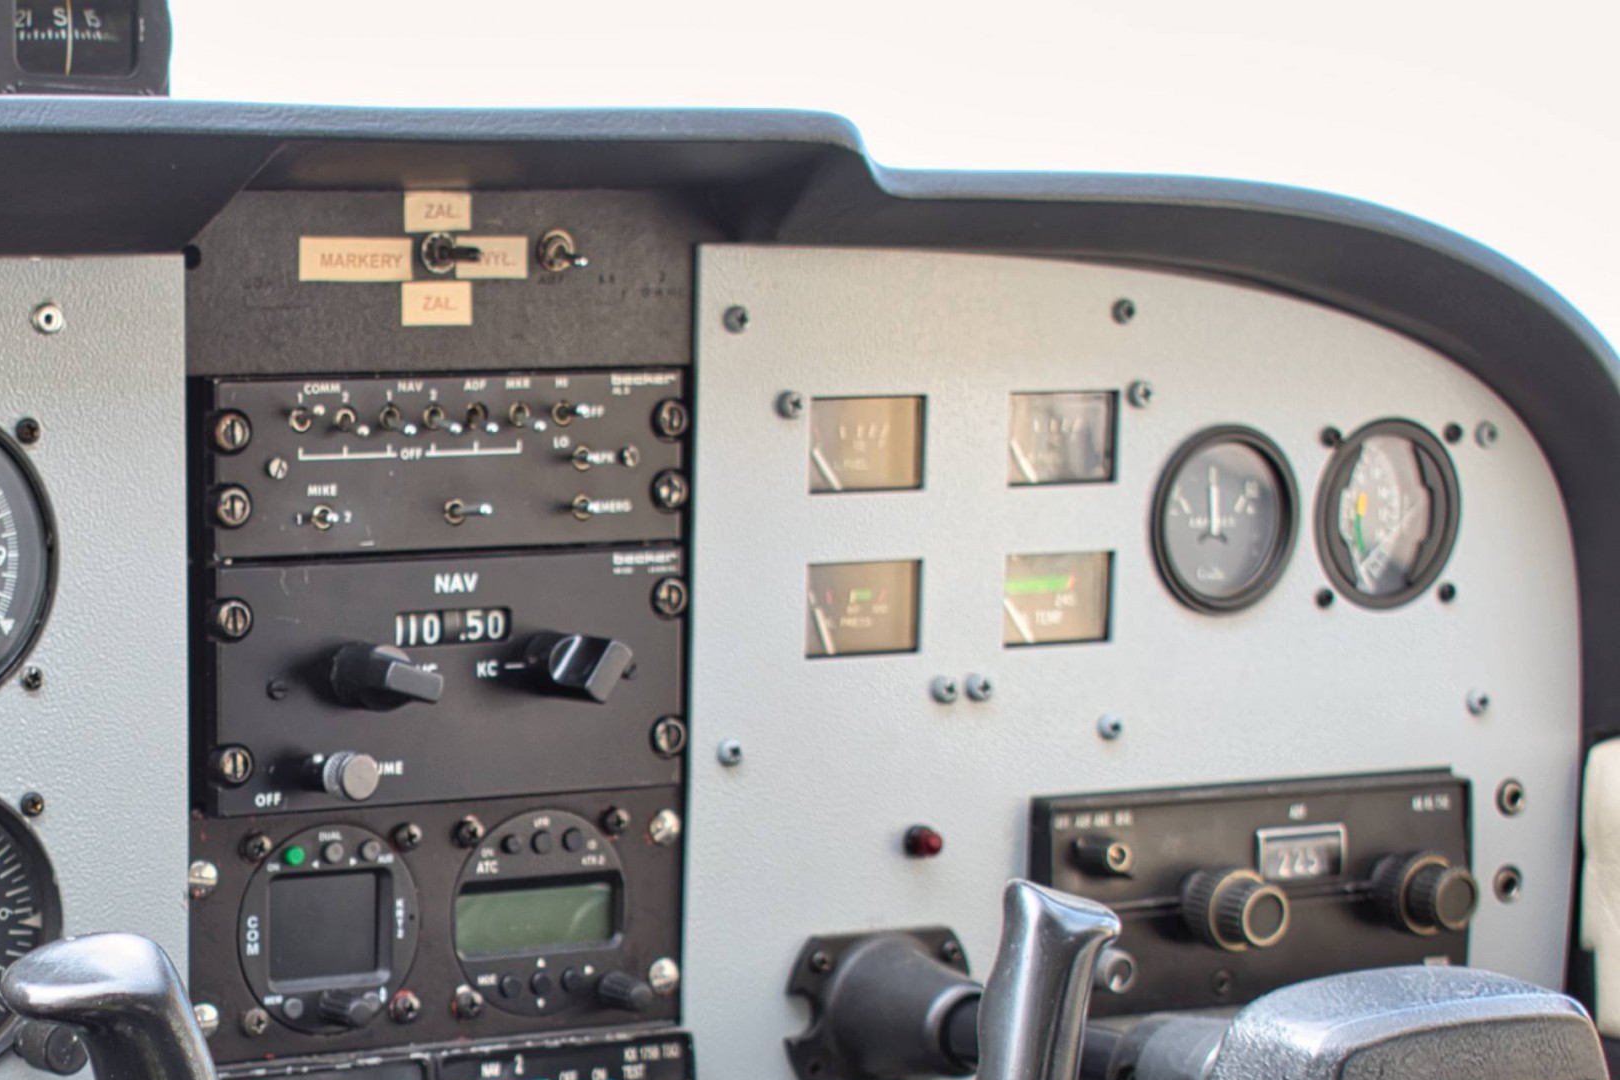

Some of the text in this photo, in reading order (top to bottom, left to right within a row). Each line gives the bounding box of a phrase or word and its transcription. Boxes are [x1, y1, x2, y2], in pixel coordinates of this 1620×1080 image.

[319, 252, 404, 269] MARKERY
[303, 382, 341, 395] COMM
[397, 380, 424, 393] NAV
[463, 379, 487, 391] ADF
[400, 447, 423, 460] OFF
[307, 484, 338, 497] MIKE
[433, 572, 479, 594] NAV
[475, 660, 499, 678] KC
[254, 792, 282, 808] OFF
[476, 860, 499, 874] ATC
[246, 915, 260, 956] COM
[622, 1063, 647, 1080] TEST
